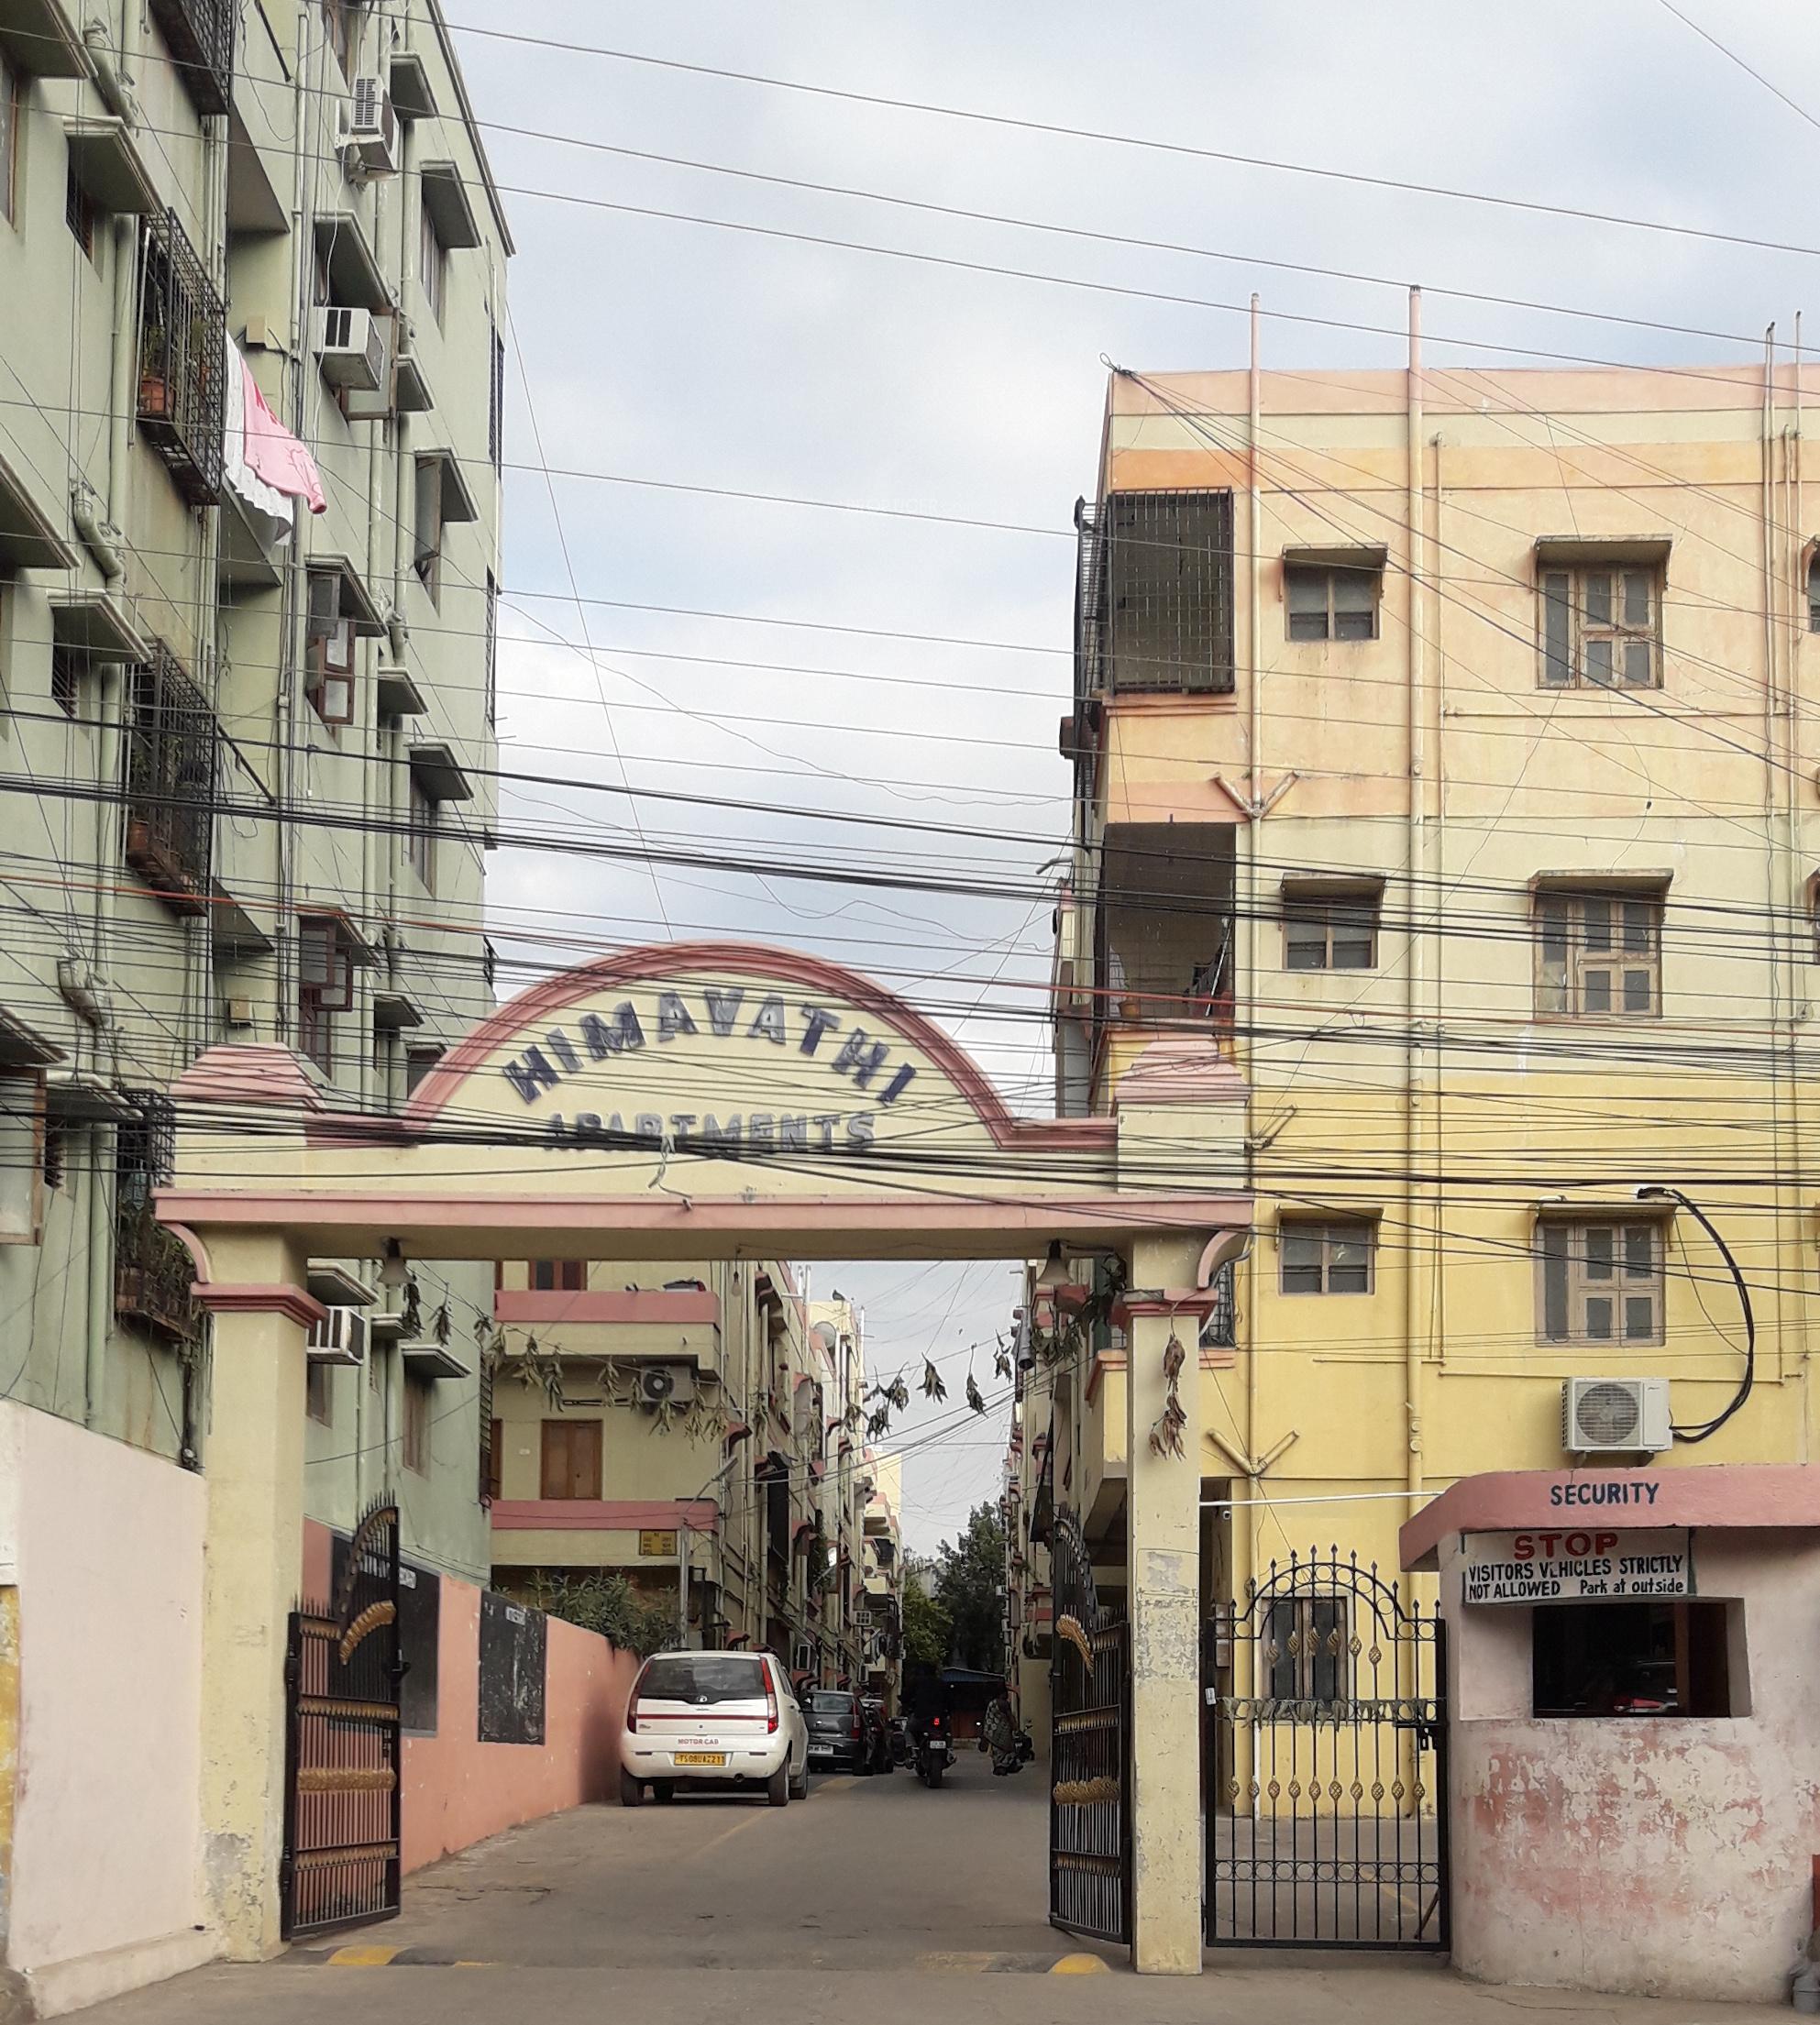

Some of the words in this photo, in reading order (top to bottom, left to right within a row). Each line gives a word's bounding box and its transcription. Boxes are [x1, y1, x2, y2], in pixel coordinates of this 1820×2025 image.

[502, 988, 917, 1106] HIMAVATHI
[1550, 1482, 1660, 1505] SECURITY
[1514, 1532, 1618, 1560] STOP
[1469, 1562, 1534, 1582] VISITORS
[1539, 1557, 1612, 1578] VEHICLES
[1619, 1555, 1683, 1574] STRICTLY
[1469, 1583, 1491, 1600] NOT
[1494, 1580, 1561, 1598] ALLOWED
[1580, 1579, 1607, 1595] Park
[1613, 1578, 1626, 1593] at
[1631, 1578, 1683, 1593] outside
